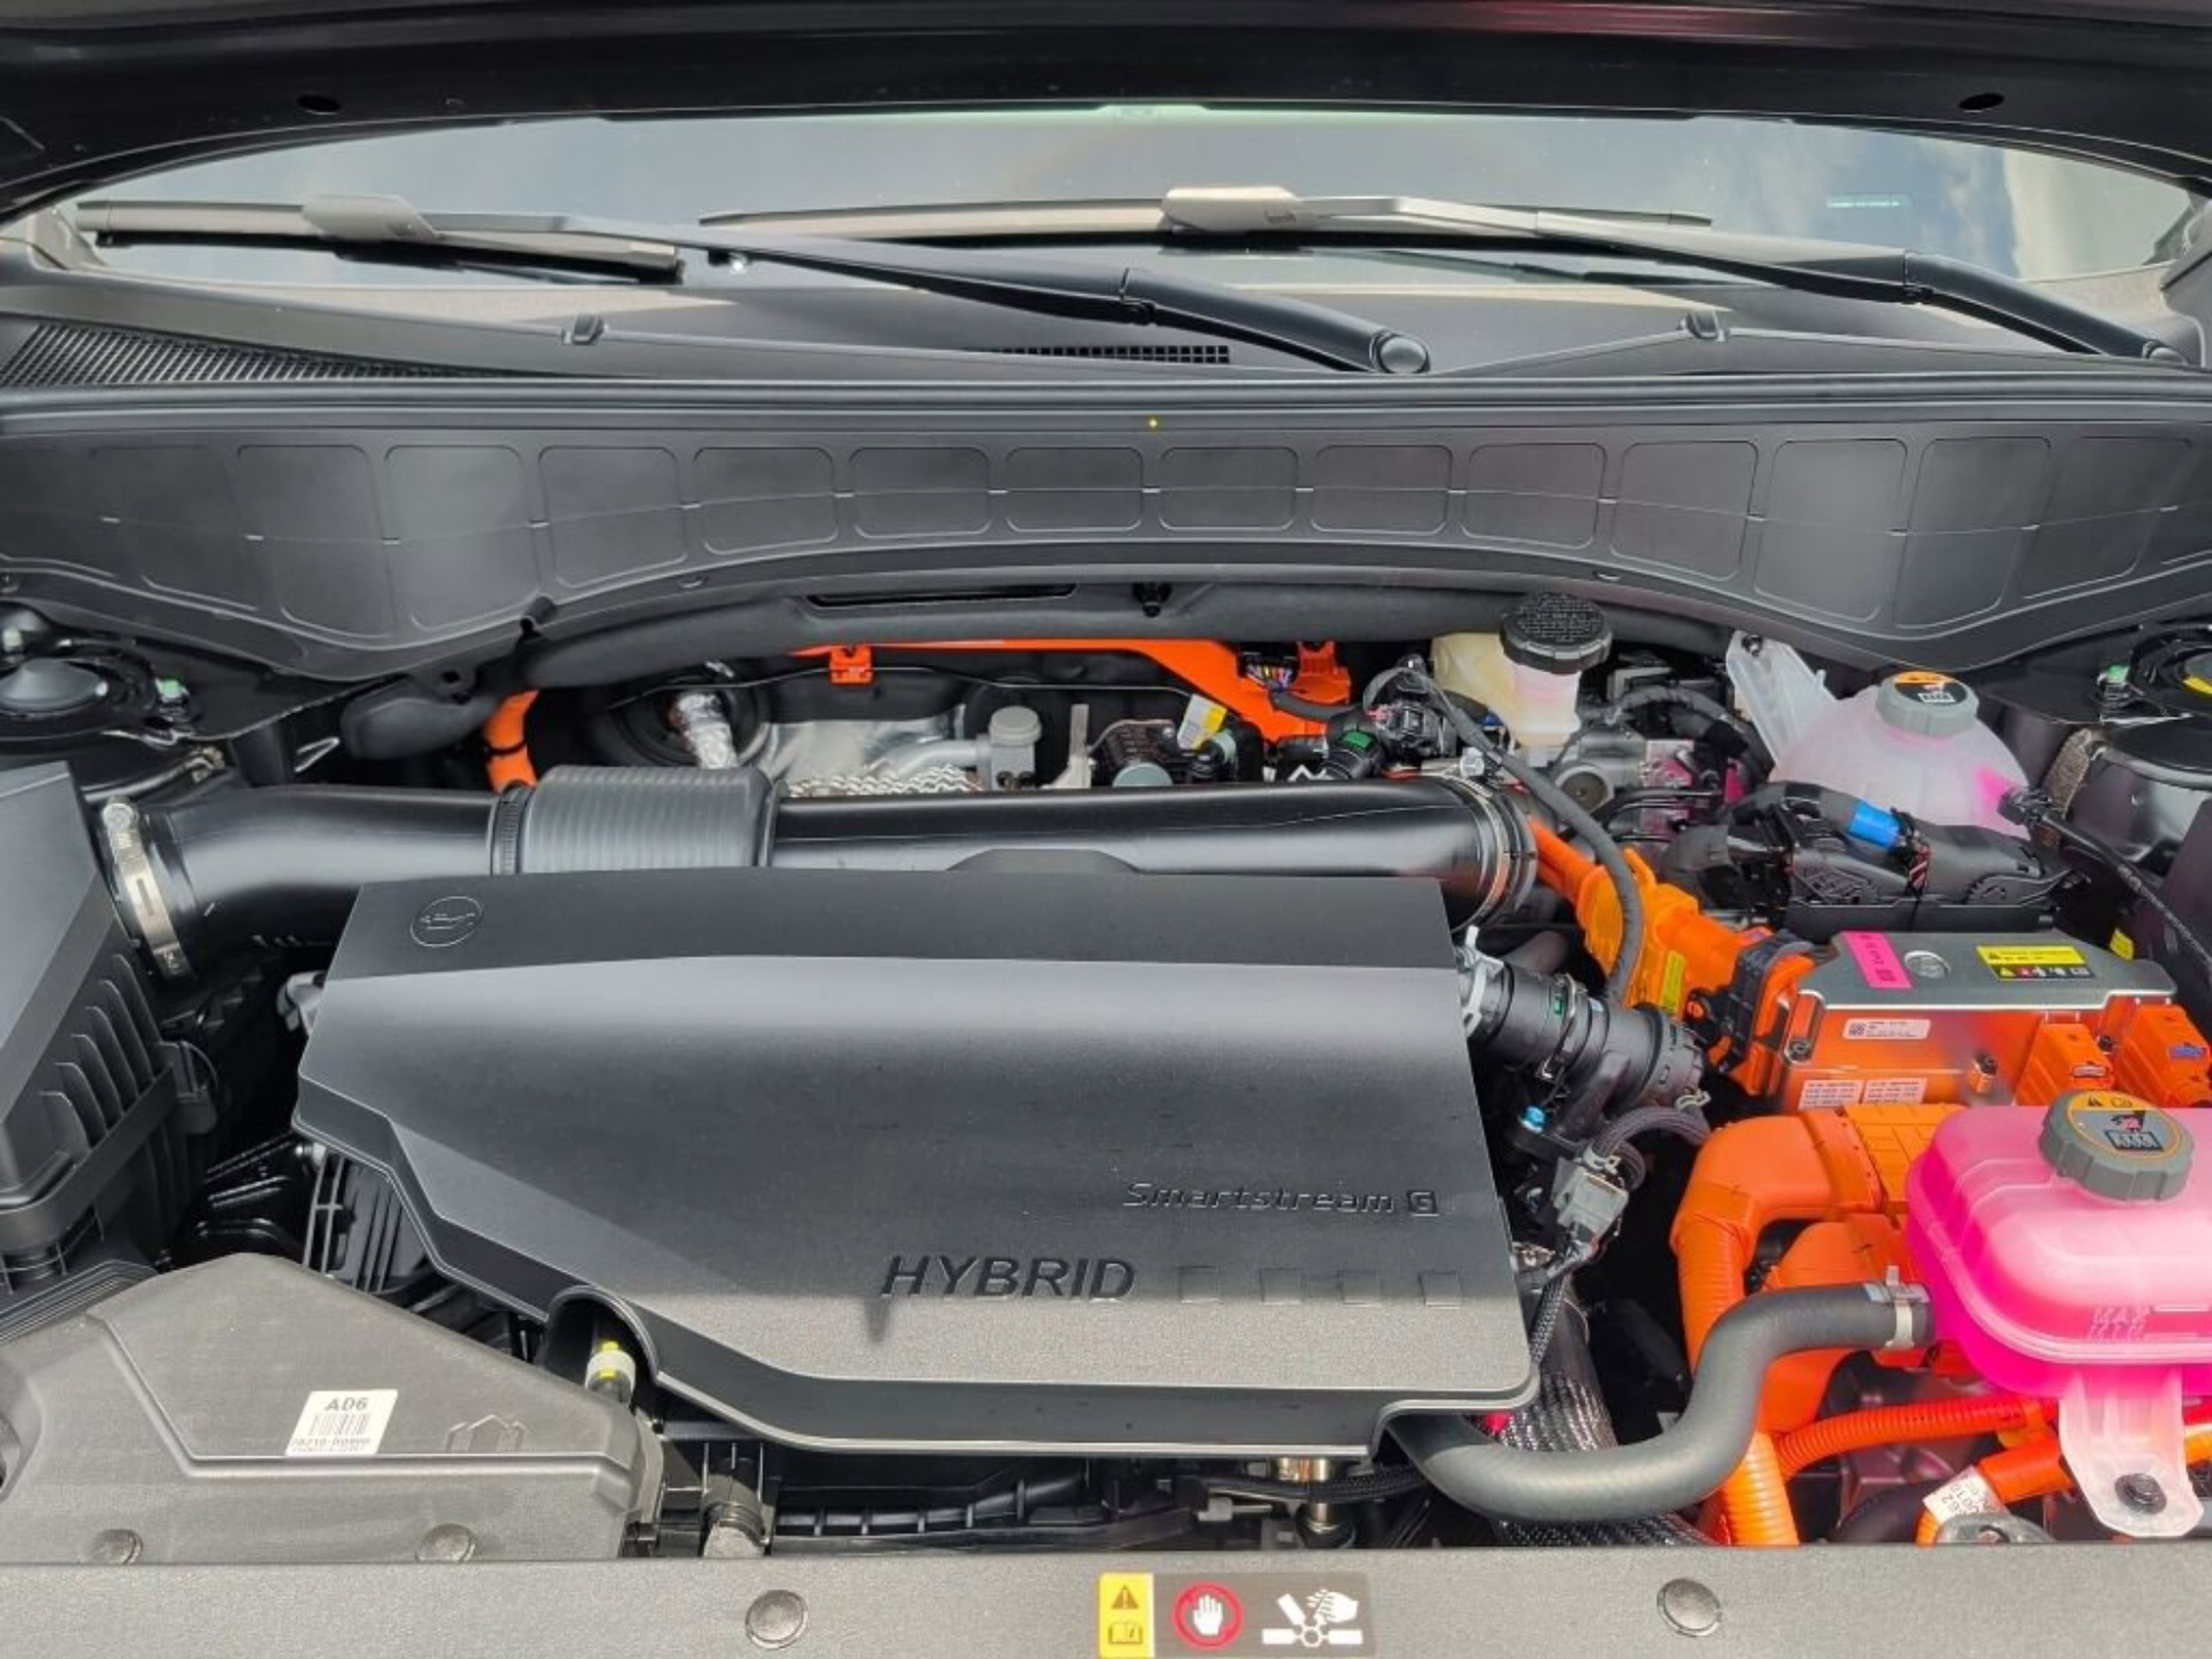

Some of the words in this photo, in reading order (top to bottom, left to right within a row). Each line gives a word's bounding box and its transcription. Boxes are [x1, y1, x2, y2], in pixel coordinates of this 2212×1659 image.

[1123, 1183, 1394, 1214] Smartstream
[1408, 1190, 1439, 1215] G
[880, 1254, 1136, 1300] HYBRID
[325, 1396, 369, 1411] AD6
